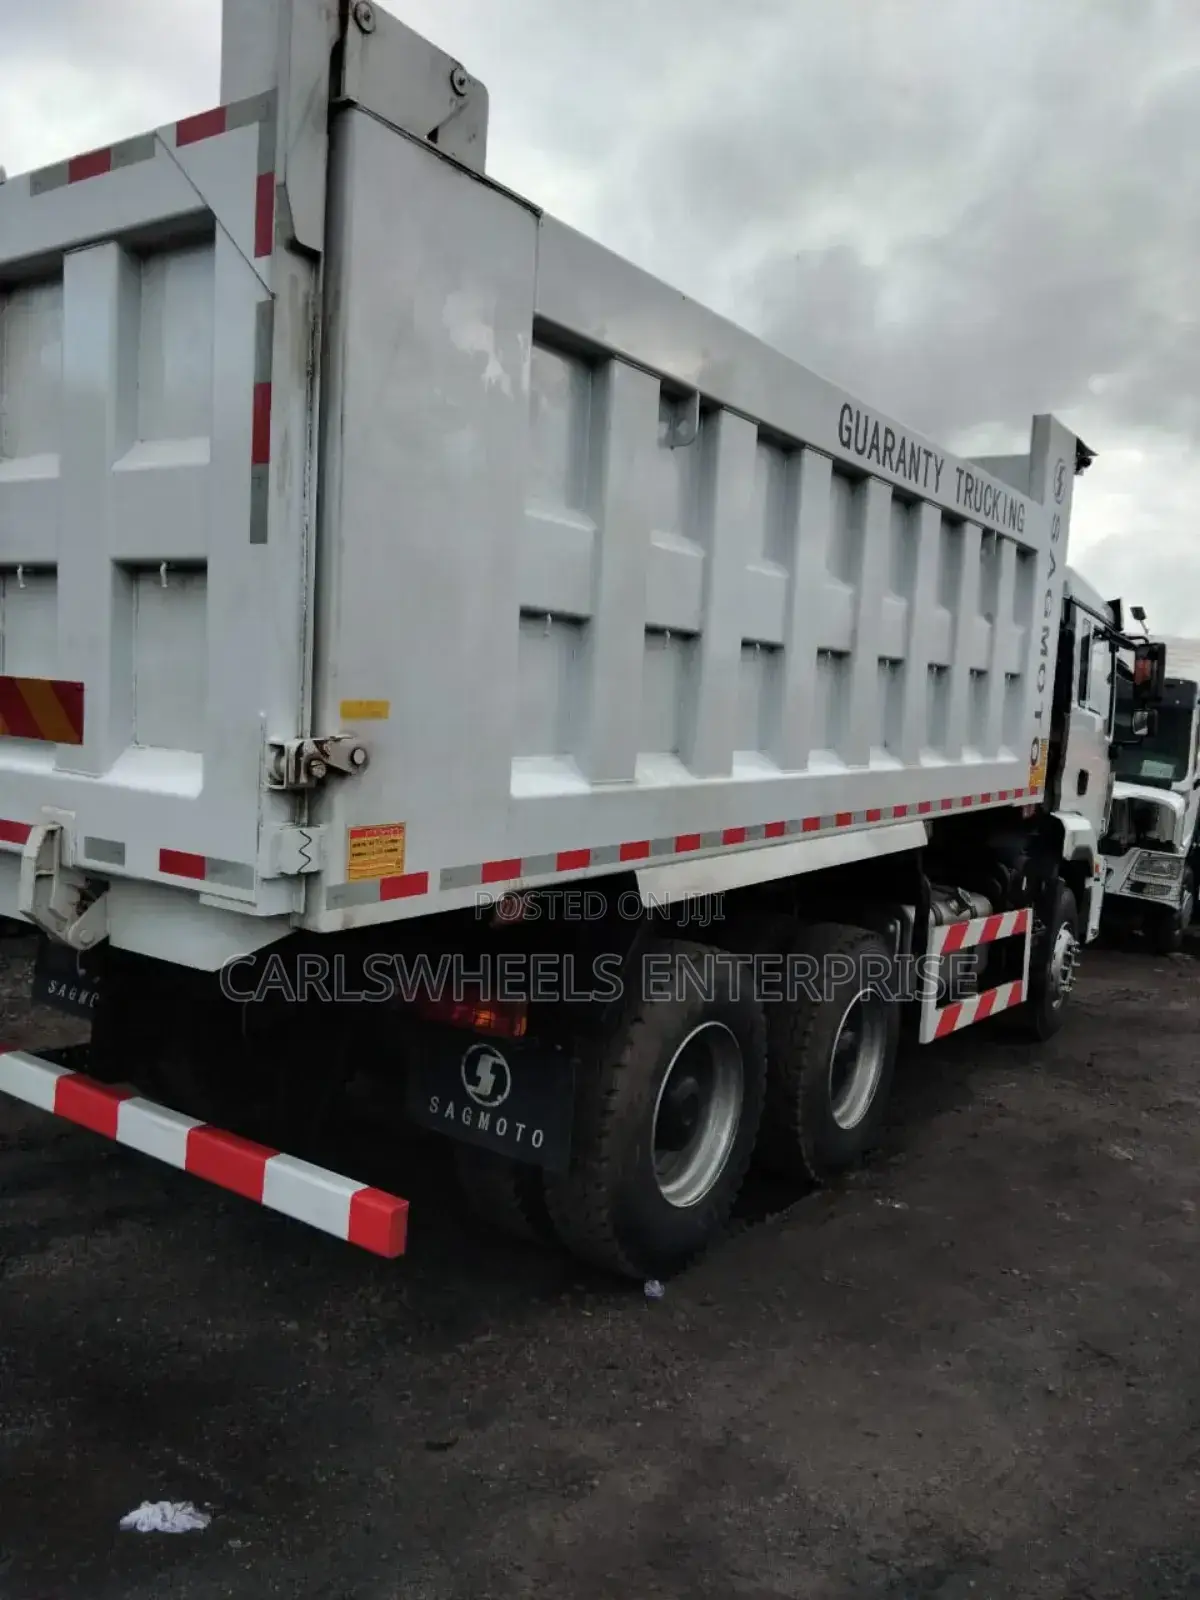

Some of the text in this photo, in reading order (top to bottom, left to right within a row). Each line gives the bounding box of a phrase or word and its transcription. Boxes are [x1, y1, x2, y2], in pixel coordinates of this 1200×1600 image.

[838, 402, 1026, 533] GUARANTY TRUCKING
[1029, 513, 1061, 766] SAGMOTO
[429, 1095, 544, 1148] SAGMOTO
